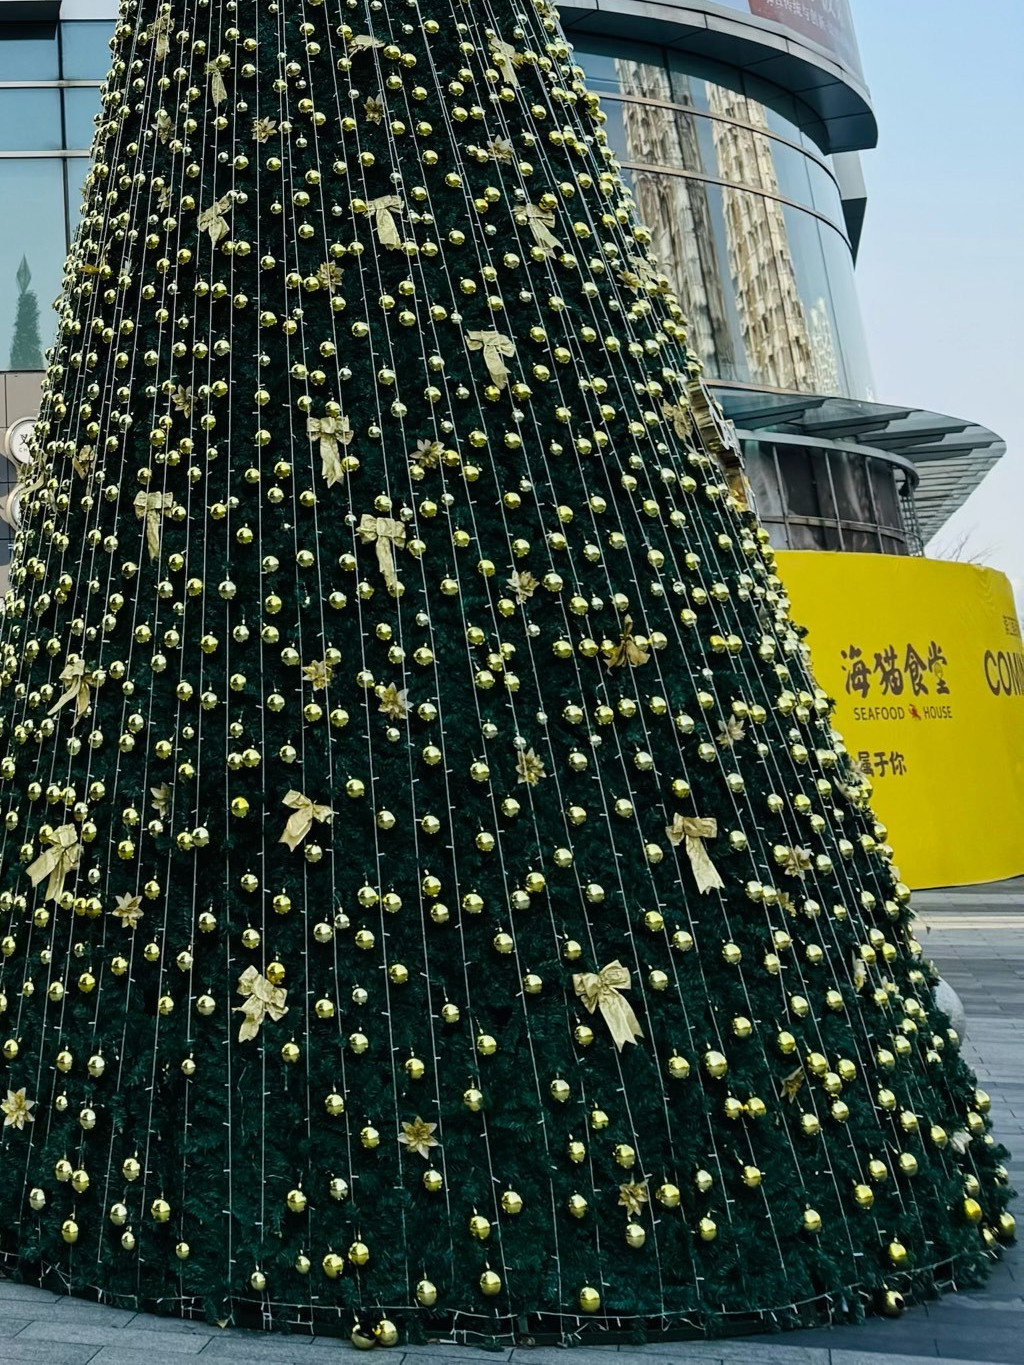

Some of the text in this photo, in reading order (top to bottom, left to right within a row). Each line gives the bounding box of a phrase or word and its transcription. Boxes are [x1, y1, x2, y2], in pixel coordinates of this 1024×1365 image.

[840, 641, 950, 699] 海猫食堂
[853, 706, 953, 721] SEAFOOD HOUSE
[858, 751, 907, 777] 属于你
